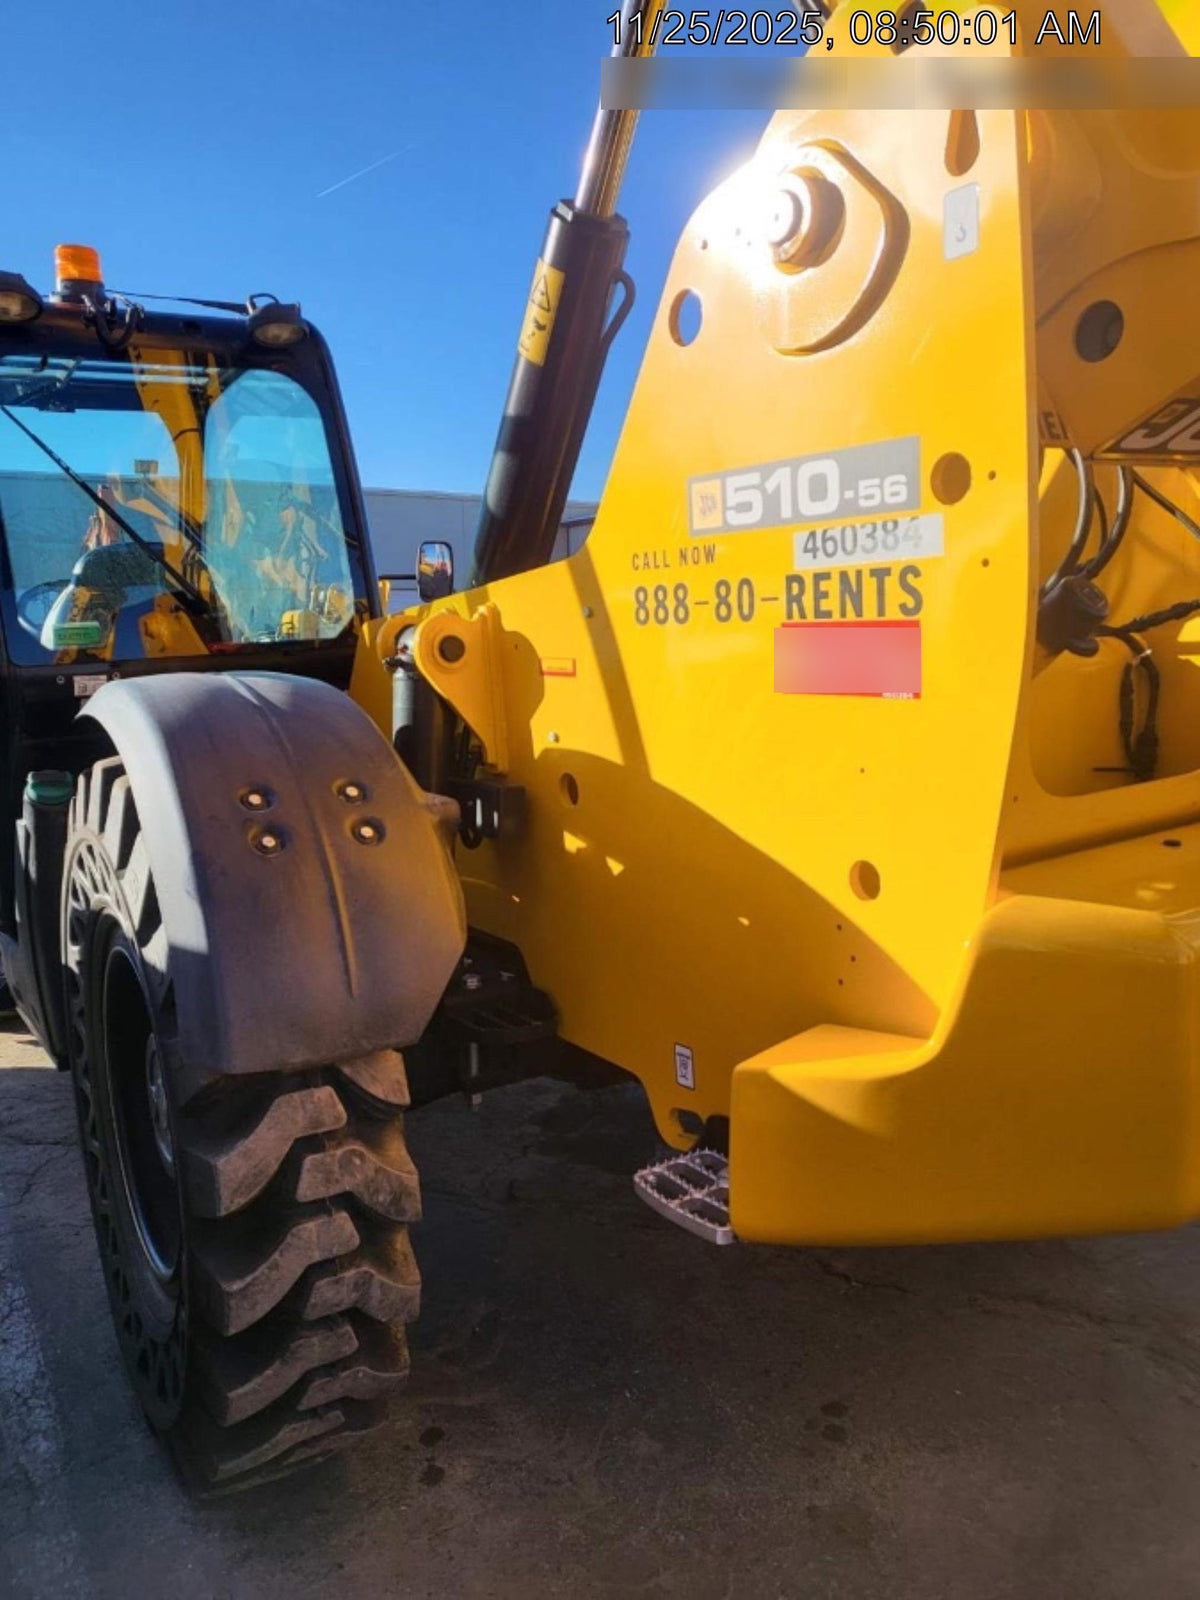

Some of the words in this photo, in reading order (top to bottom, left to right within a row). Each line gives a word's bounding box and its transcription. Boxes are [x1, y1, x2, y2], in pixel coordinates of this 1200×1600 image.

[724, 457, 908, 526] 510-56
[632, 550, 671, 571] CALL
[679, 544, 716, 566] NOW
